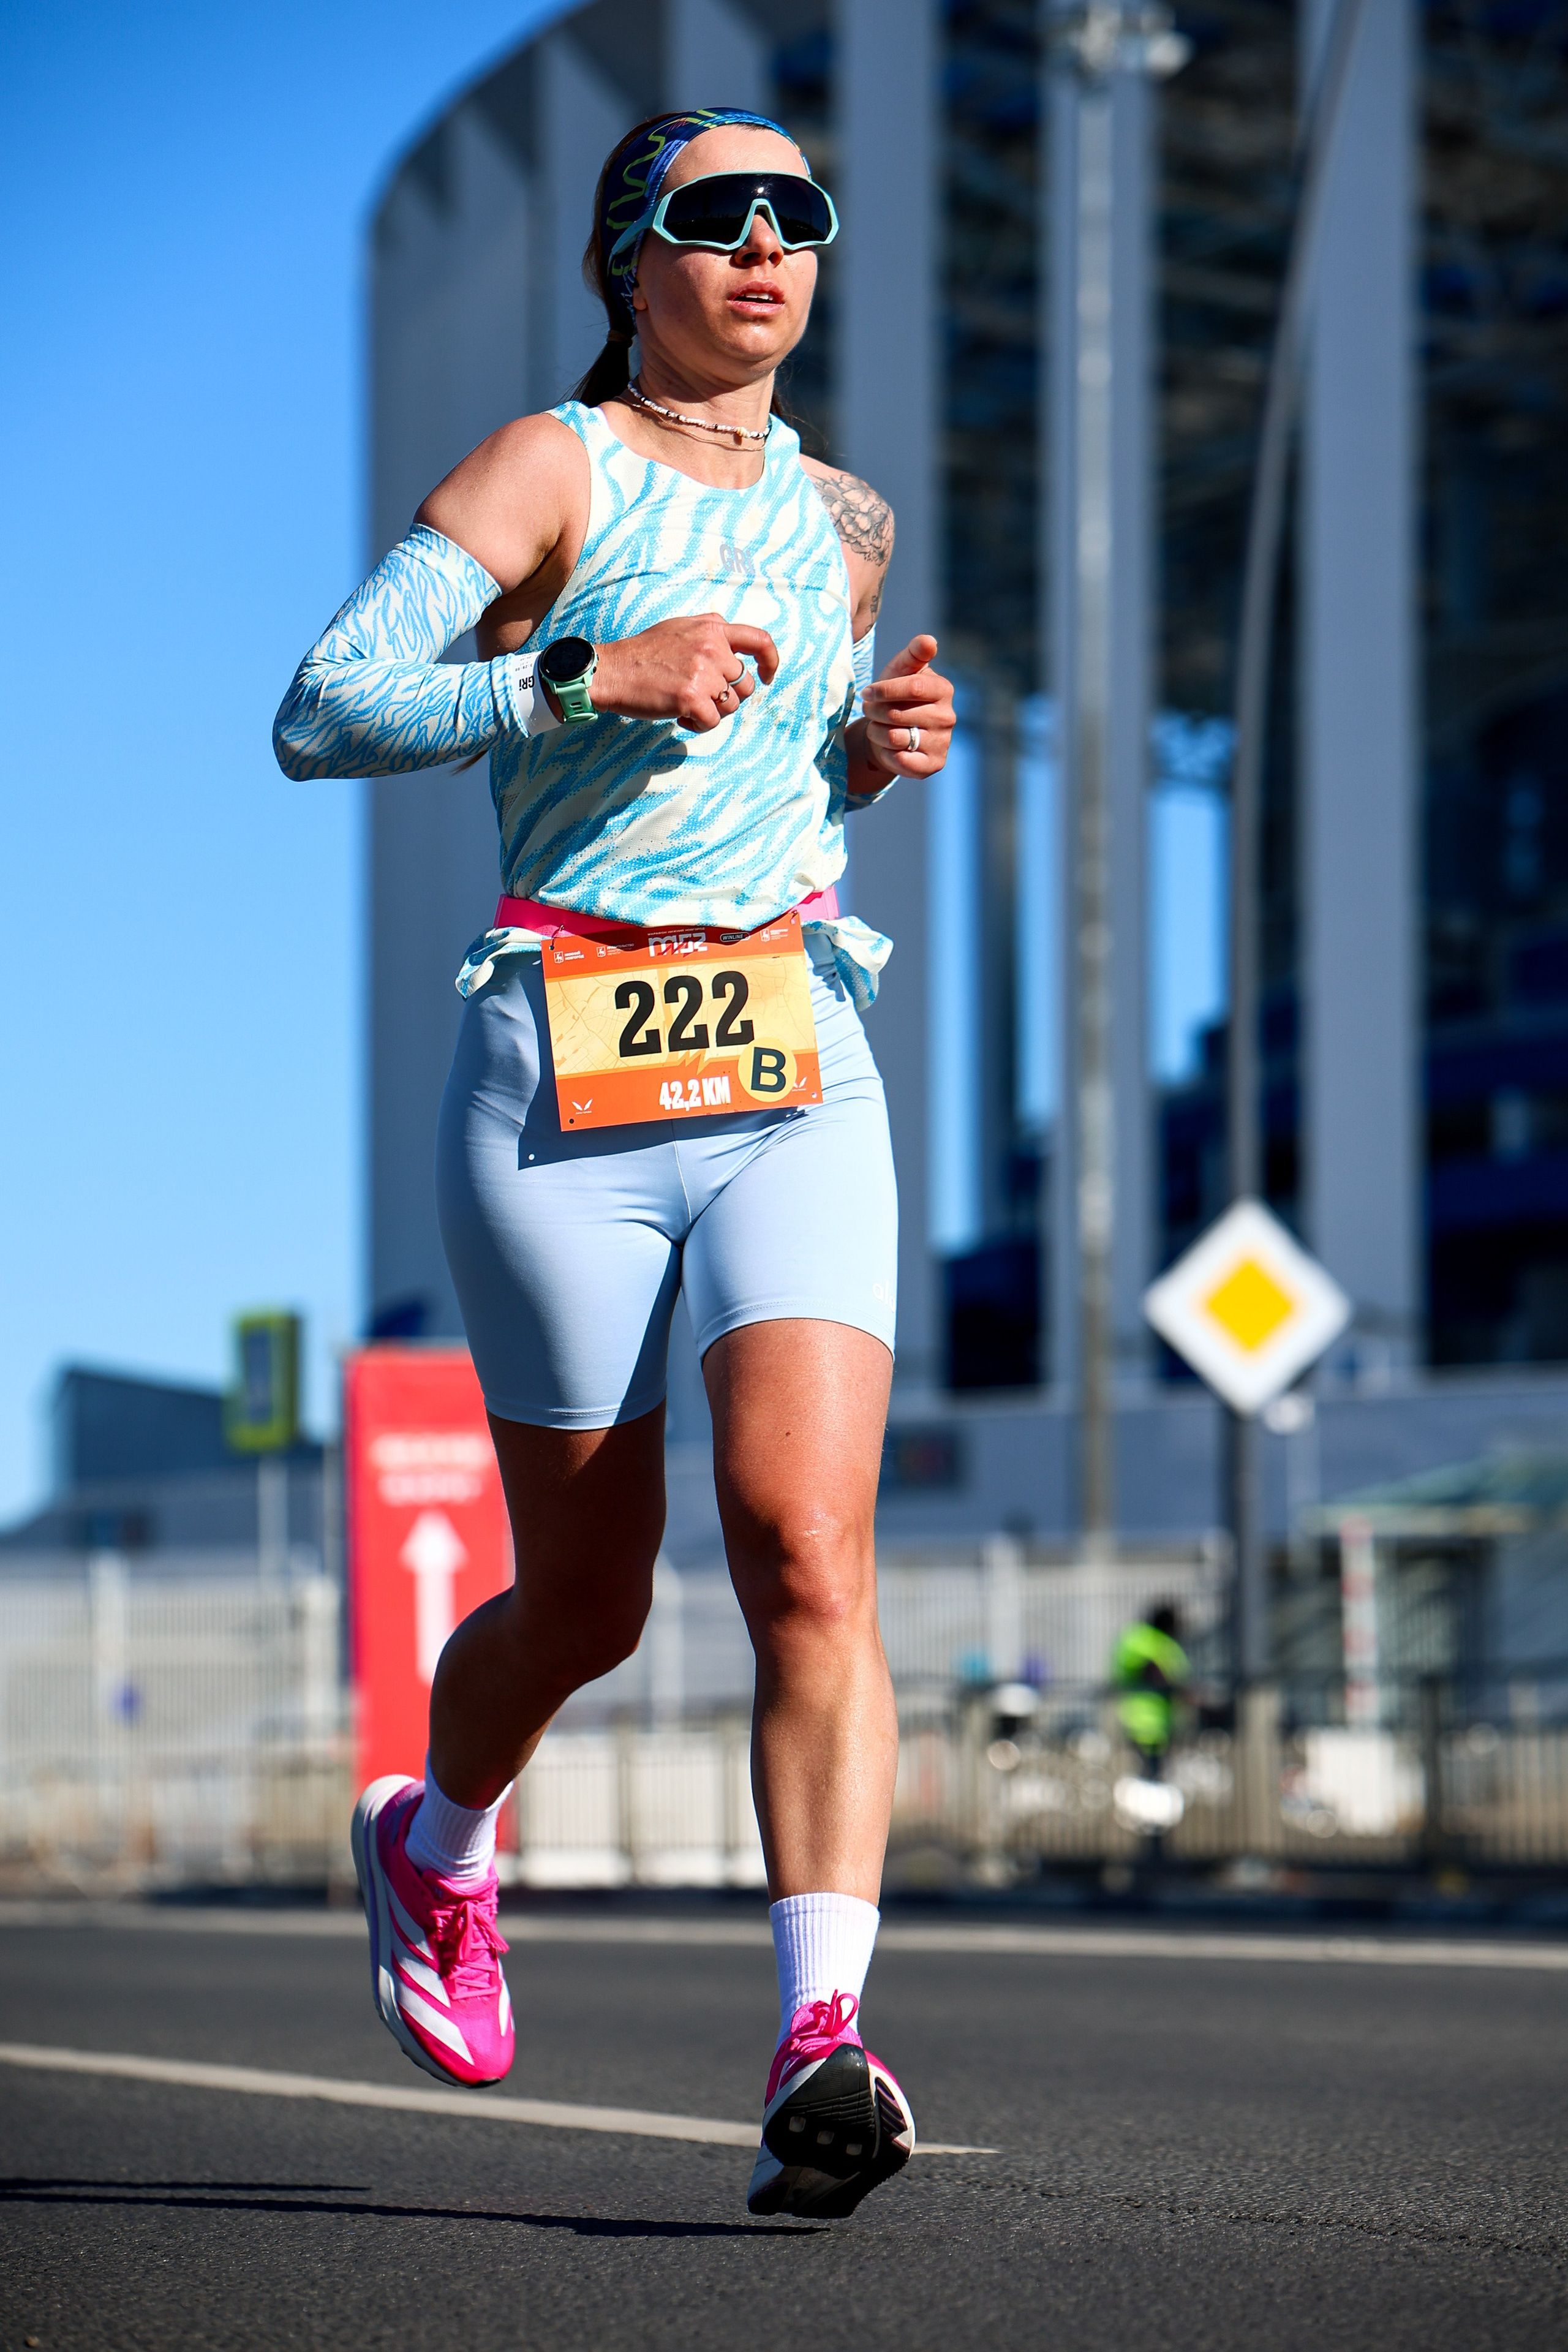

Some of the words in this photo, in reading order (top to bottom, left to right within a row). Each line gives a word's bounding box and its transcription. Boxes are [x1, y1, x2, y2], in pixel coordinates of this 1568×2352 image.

[719, 544, 755, 576] GRi
[519, 675, 535, 692] GRi
[614, 971, 755, 1058] 222
[750, 1046, 786, 1093] B
[659, 1079, 702, 1112] 42,2
